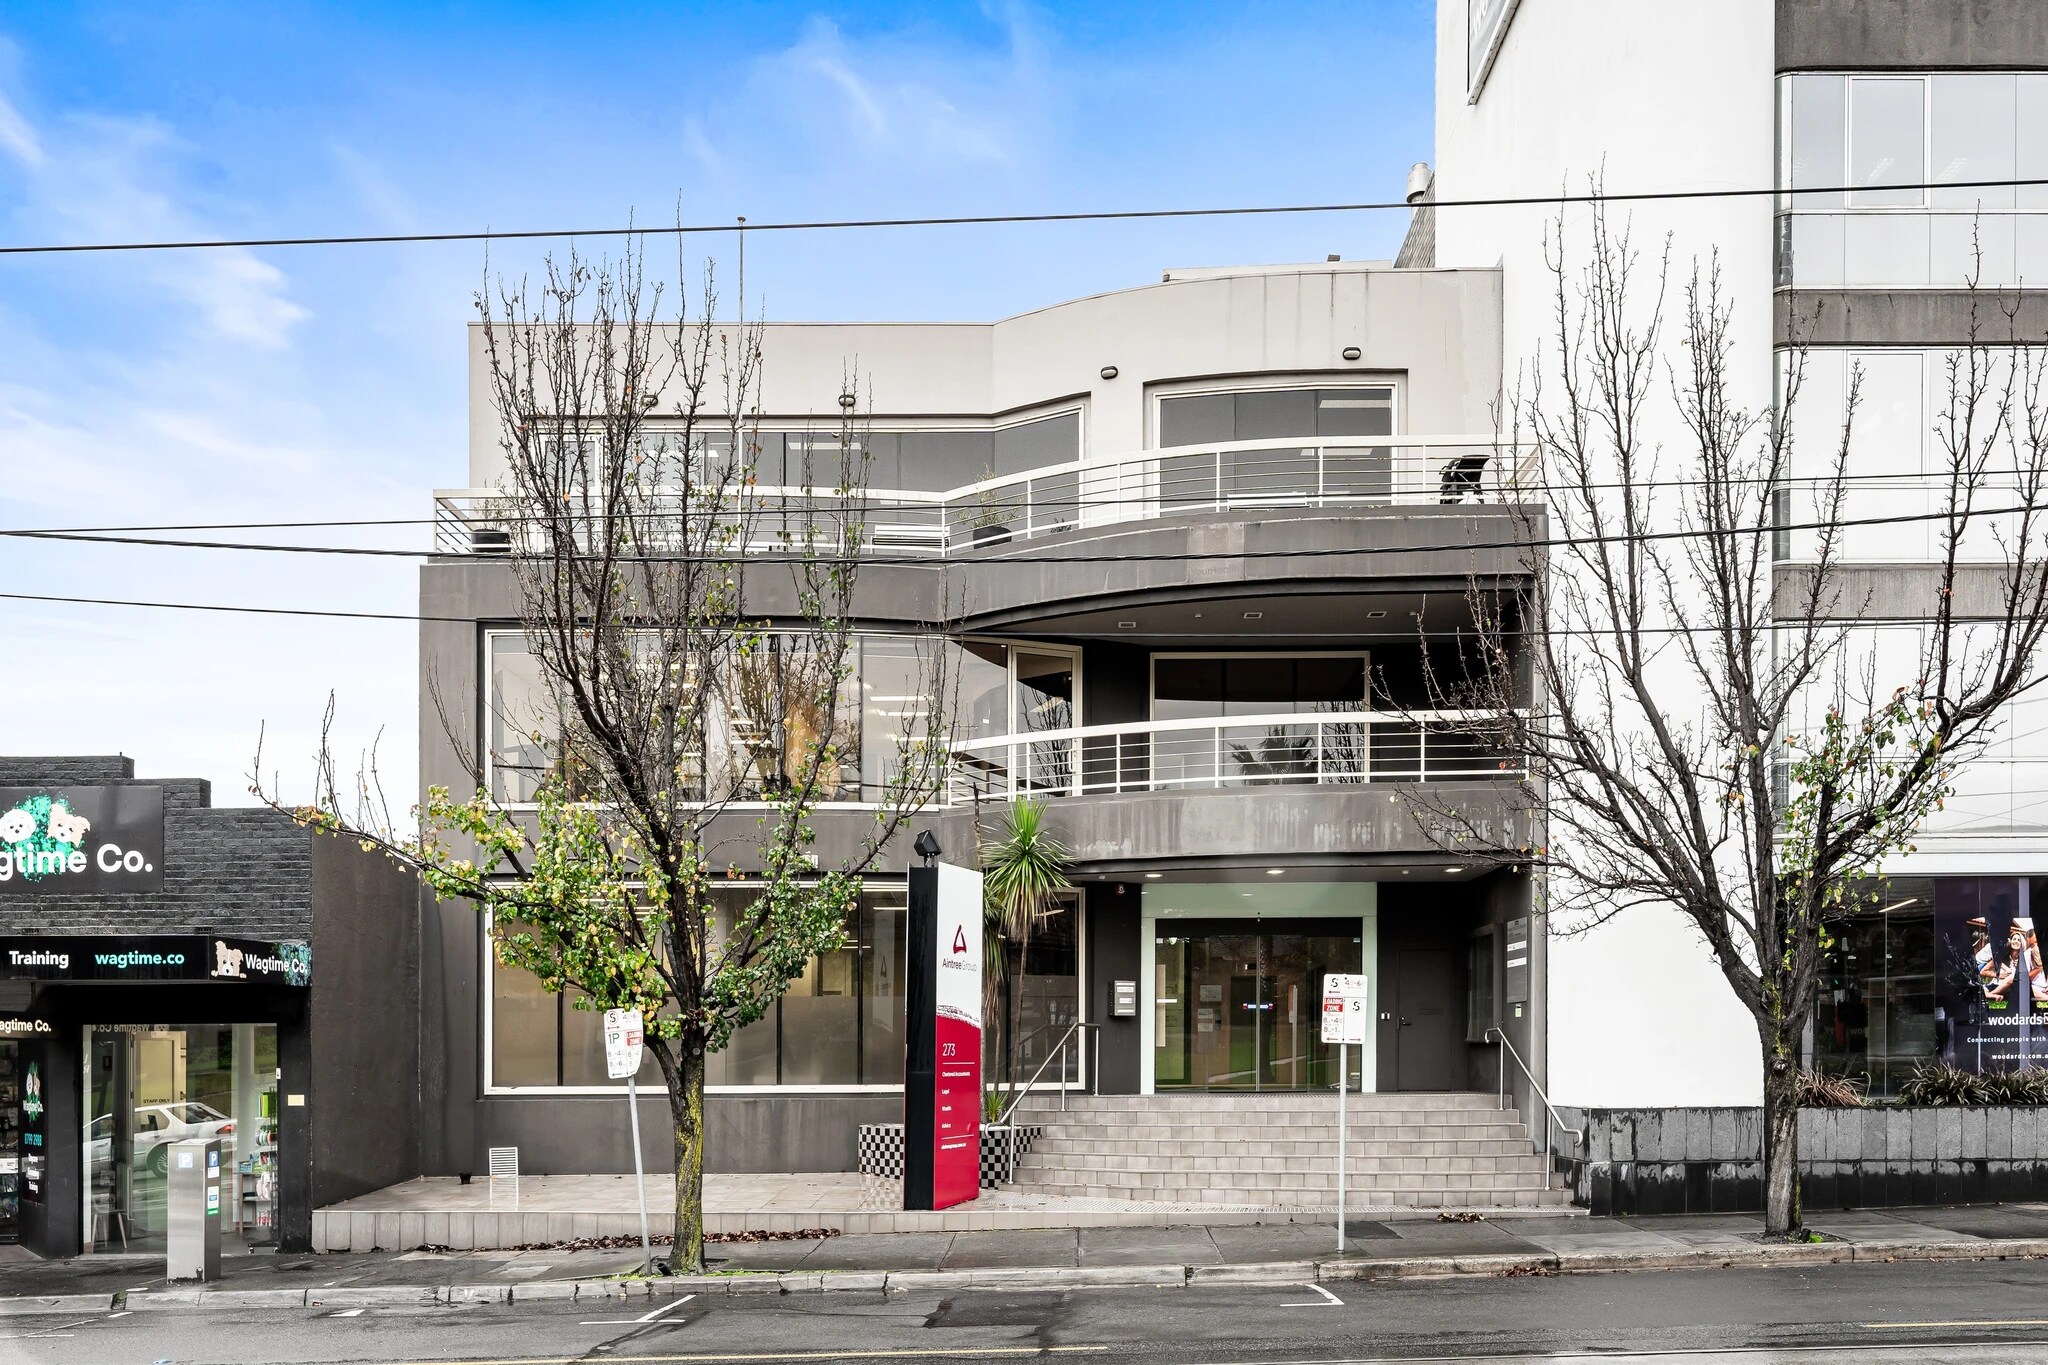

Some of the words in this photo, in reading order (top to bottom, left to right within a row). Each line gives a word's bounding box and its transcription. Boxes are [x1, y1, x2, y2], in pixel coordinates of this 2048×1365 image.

[97, 843, 154, 873] Co.
[9, 950, 69, 969] Training
[95, 951, 185, 969] wagtime.co
[245, 953, 289, 974] Wagtime
[292, 958, 308, 976] Co.
[35, 1019, 52, 1032] Co.
[1988, 1013, 2043, 1026] woodards
[608, 1033, 620, 1045] 1P
[942, 1043, 956, 1056] 273
